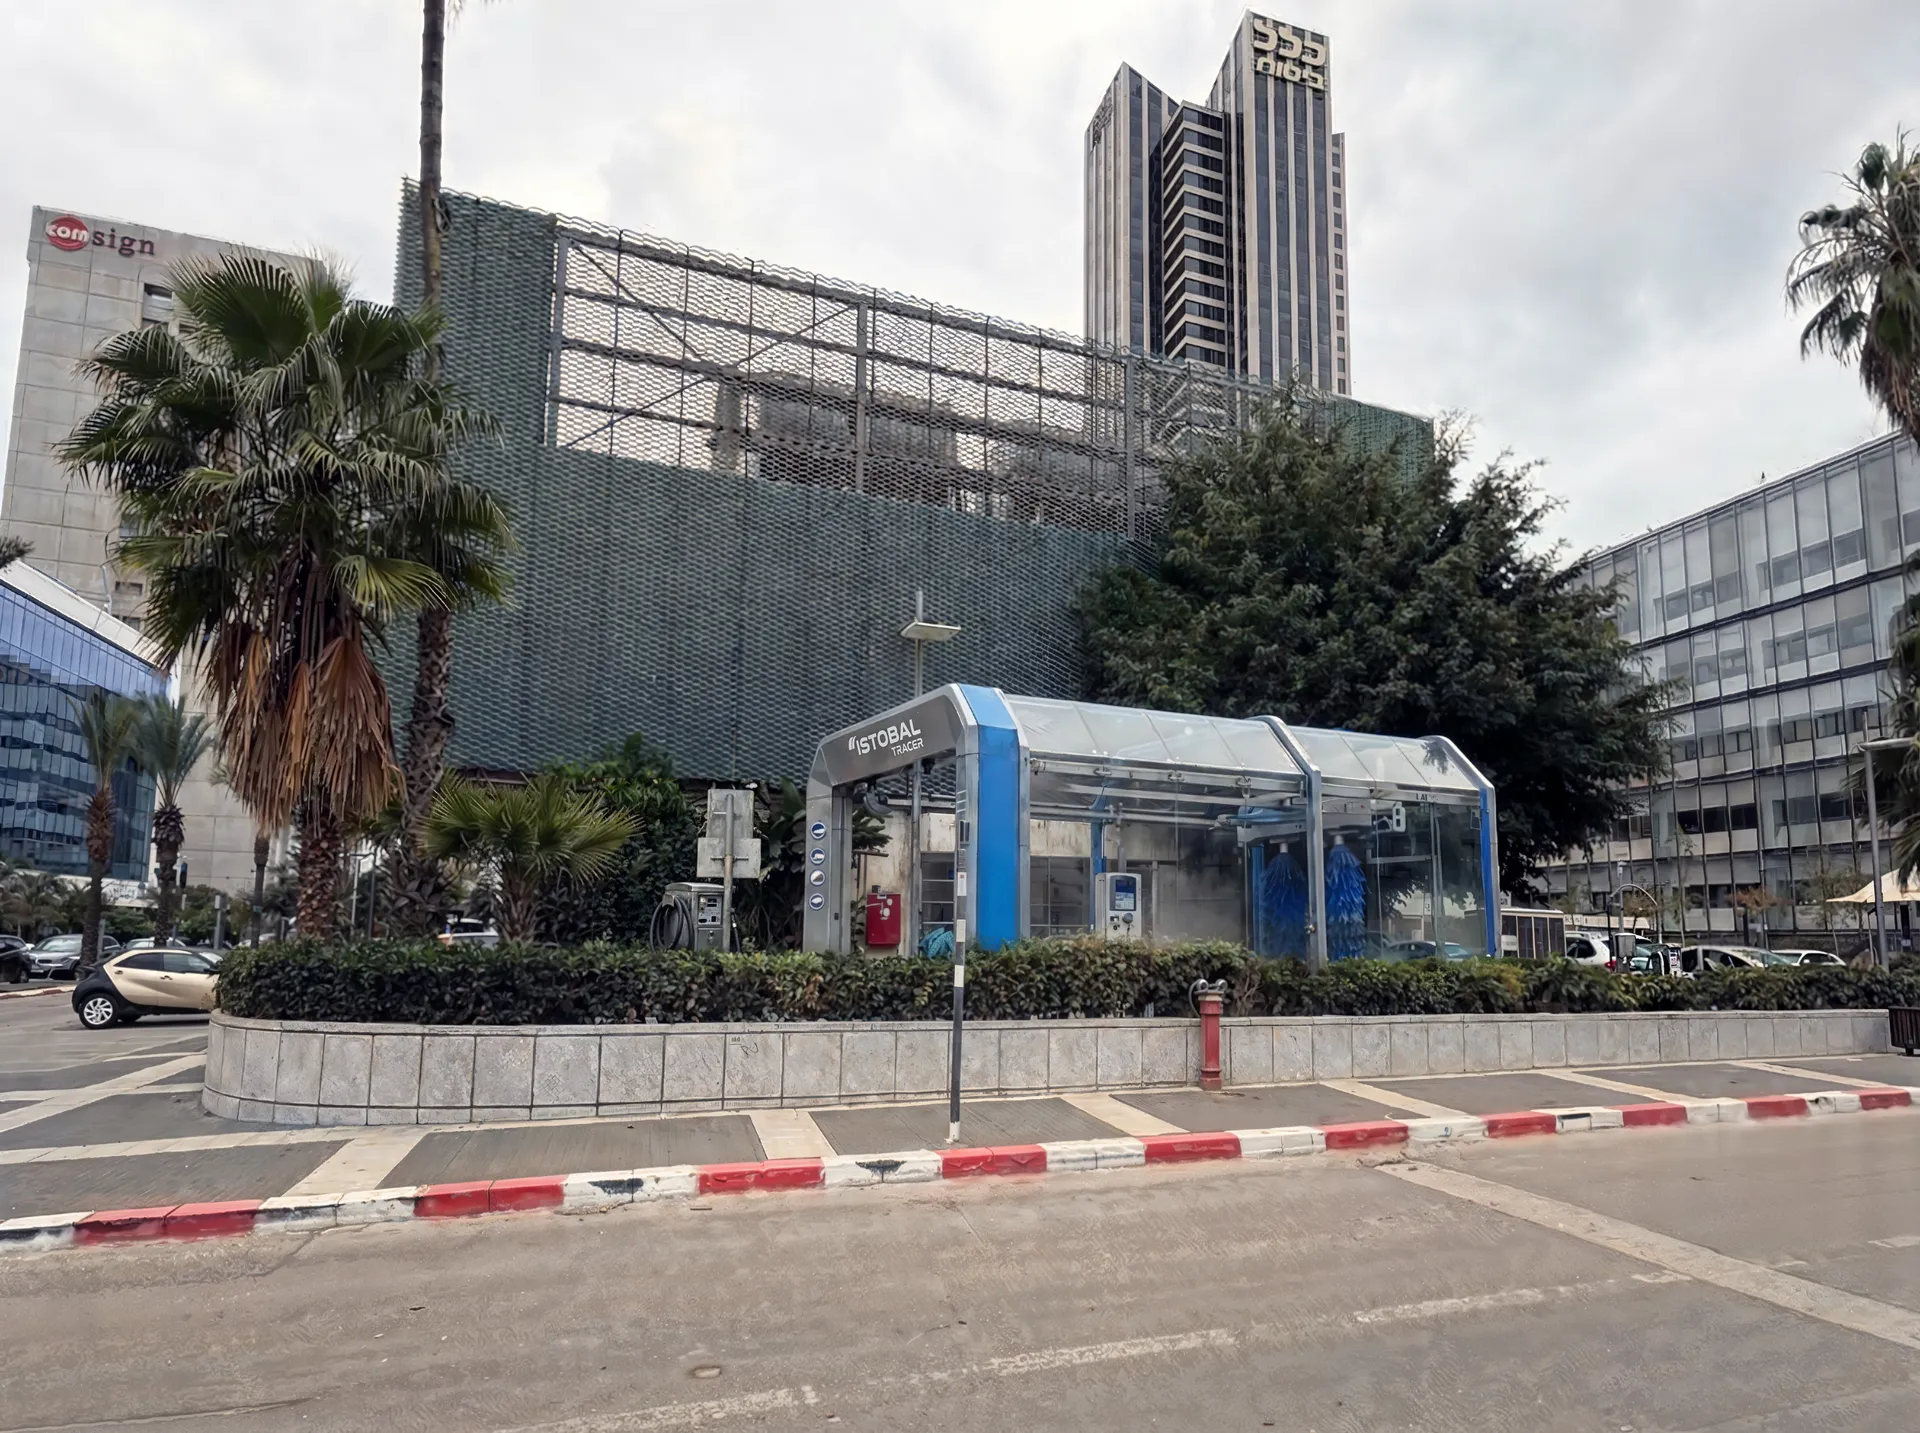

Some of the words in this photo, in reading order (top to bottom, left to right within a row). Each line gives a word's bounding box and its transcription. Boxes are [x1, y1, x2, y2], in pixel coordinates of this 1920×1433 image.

[1253, 18, 1327, 67] כלל
[1256, 56, 1325, 90] ביטוח
[855, 718, 921, 756] ISTOBAL
[890, 737, 924, 757] TRACER
